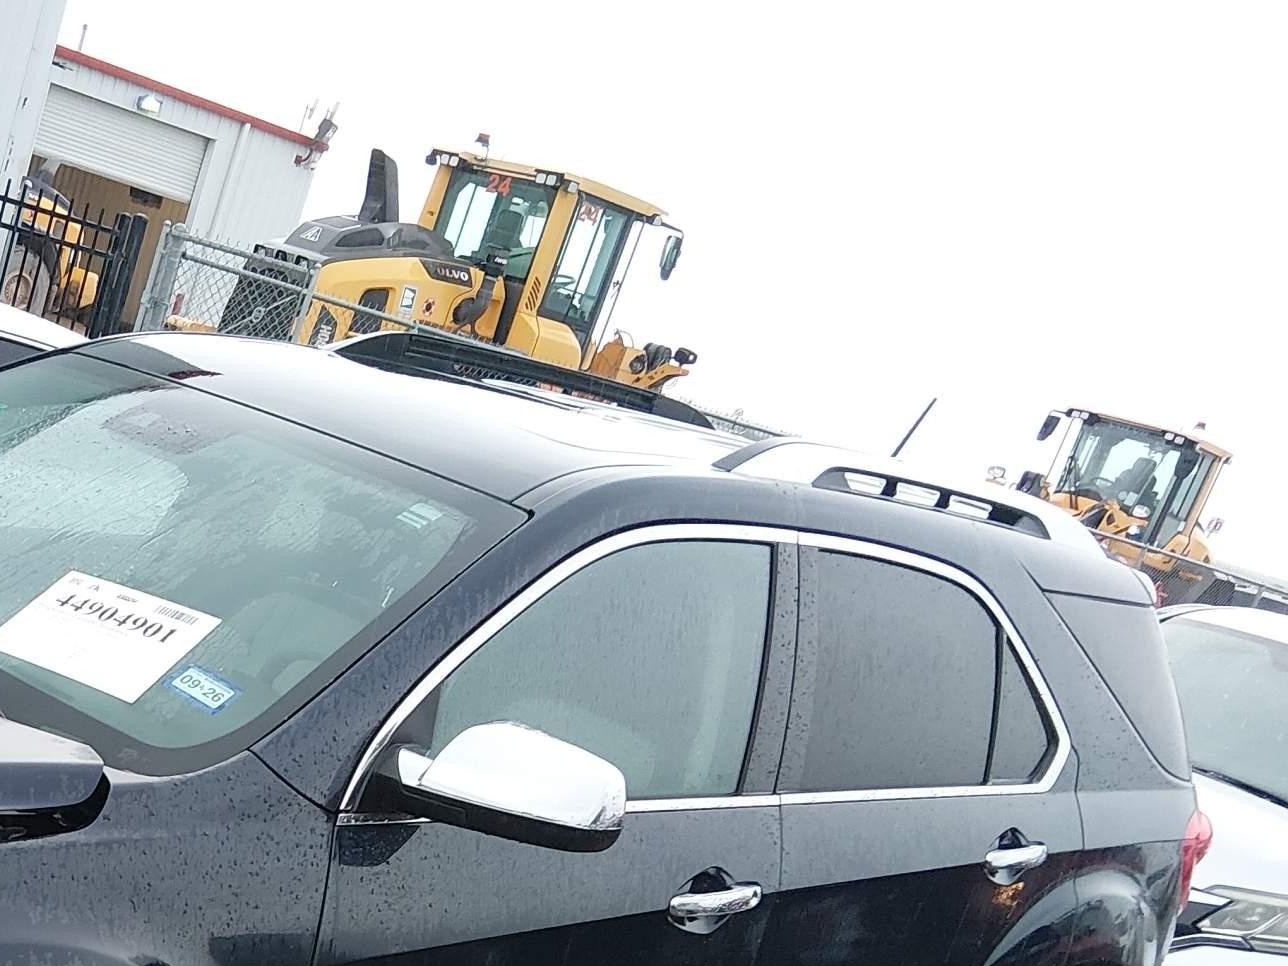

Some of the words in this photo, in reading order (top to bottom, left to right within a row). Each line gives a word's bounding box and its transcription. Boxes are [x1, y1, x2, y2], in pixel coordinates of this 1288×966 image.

[486, 173, 512, 197] 24
[431, 265, 469, 282] OLVO
[56, 593, 179, 643] 44904901
[179, 674, 201, 689] 09
[202, 687, 225, 703] 26
